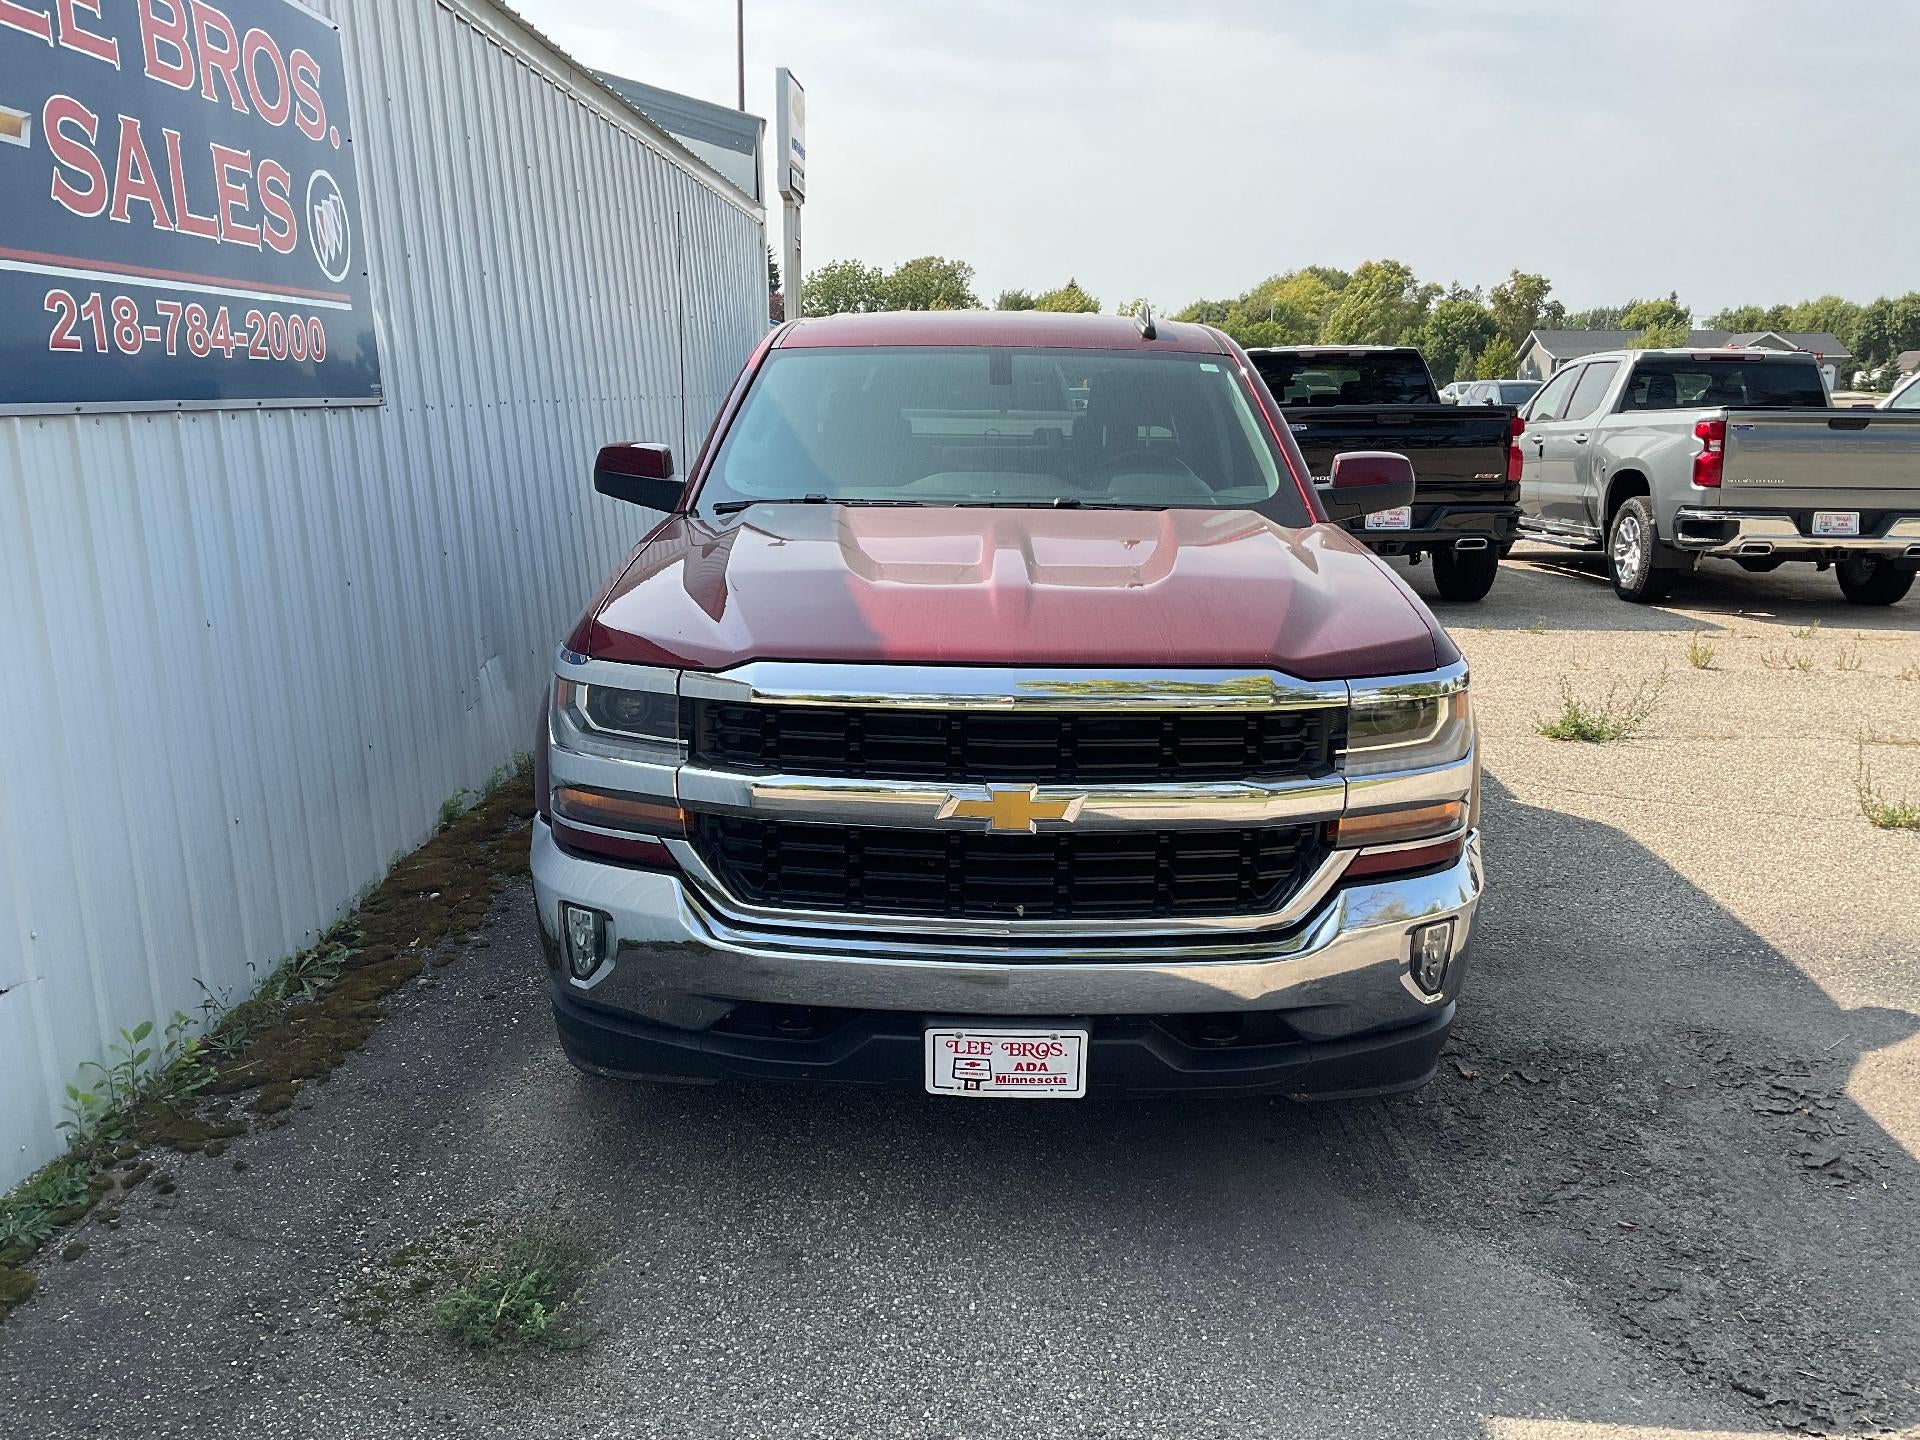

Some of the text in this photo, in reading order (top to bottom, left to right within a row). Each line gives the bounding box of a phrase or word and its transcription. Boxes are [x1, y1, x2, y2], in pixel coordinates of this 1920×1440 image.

[137, 0, 340, 150] BROS.
[43, 94, 298, 255] SALES
[44, 288, 327, 363] 218-784-2000
[945, 1040, 1068, 1060] LEE BROS.
[1013, 1062, 1049, 1072] ADA
[995, 1075, 1067, 1085] Minnesota
